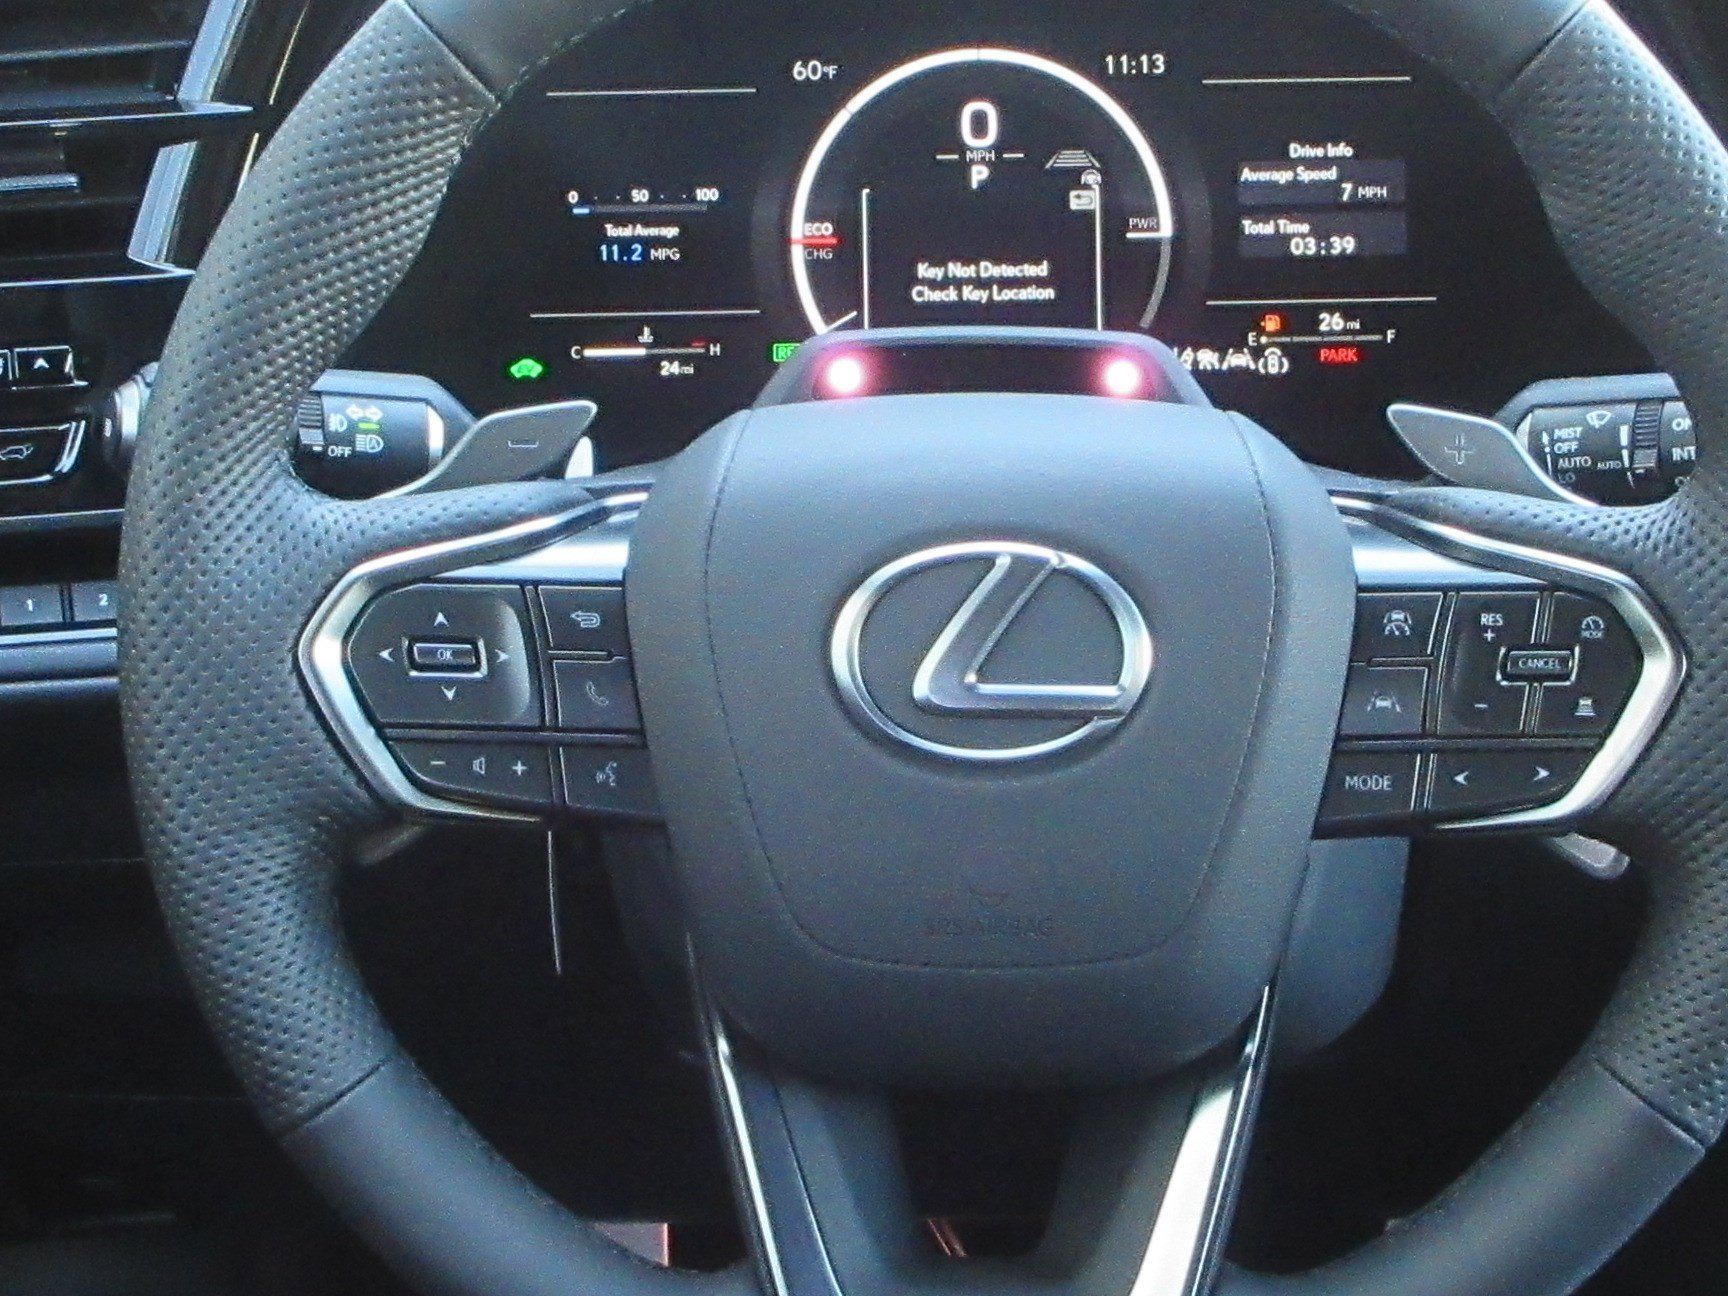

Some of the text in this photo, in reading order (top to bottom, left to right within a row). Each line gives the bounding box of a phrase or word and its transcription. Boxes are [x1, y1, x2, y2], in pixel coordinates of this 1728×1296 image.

[1105, 54, 1165, 75] 11:13
[960, 101, 998, 148] 0
[965, 150, 995, 162] MPH
[1289, 142, 1354, 159] Drive Info
[970, 164, 990, 190] P
[1240, 166, 1338, 184] Average Speed
[631, 189, 649, 203] 50
[695, 188, 719, 202] 100
[1341, 183, 1387, 201] 7 MPH
[804, 222, 833, 236] ECO
[1129, 217, 1157, 229] PWR
[1242, 219, 1309, 235] Total Time
[604, 224, 680, 239] Total Average
[600, 244, 680, 261] 11.2 MPG
[1290, 236, 1355, 255] 03:39
[803, 249, 833, 260] CHG
[917, 260, 1048, 280] Key Not Detected
[911, 285, 1055, 303] Check Key Location
[1248, 332, 1257, 346] E
[1386, 329, 1395, 344] F
[570, 346, 581, 359] C
[709, 343, 721, 356] H
[1320, 348, 1358, 362] PARK
[1554, 427, 1583, 440] MIST
[328, 446, 352, 458] OFF
[1554, 442, 1578, 454] OFF
[1672, 446, 1696, 461] INT
[1558, 456, 1591, 469] AUTO
[1597, 461, 1621, 470] AUTO
[26, 599, 33, 611] 1
[98, 593, 109, 606] 2
[1480, 613, 1503, 627] RES
[437, 649, 453, 661] OK
[1518, 658, 1562, 670] CANCEL
[1344, 775, 1393, 791] MODE
